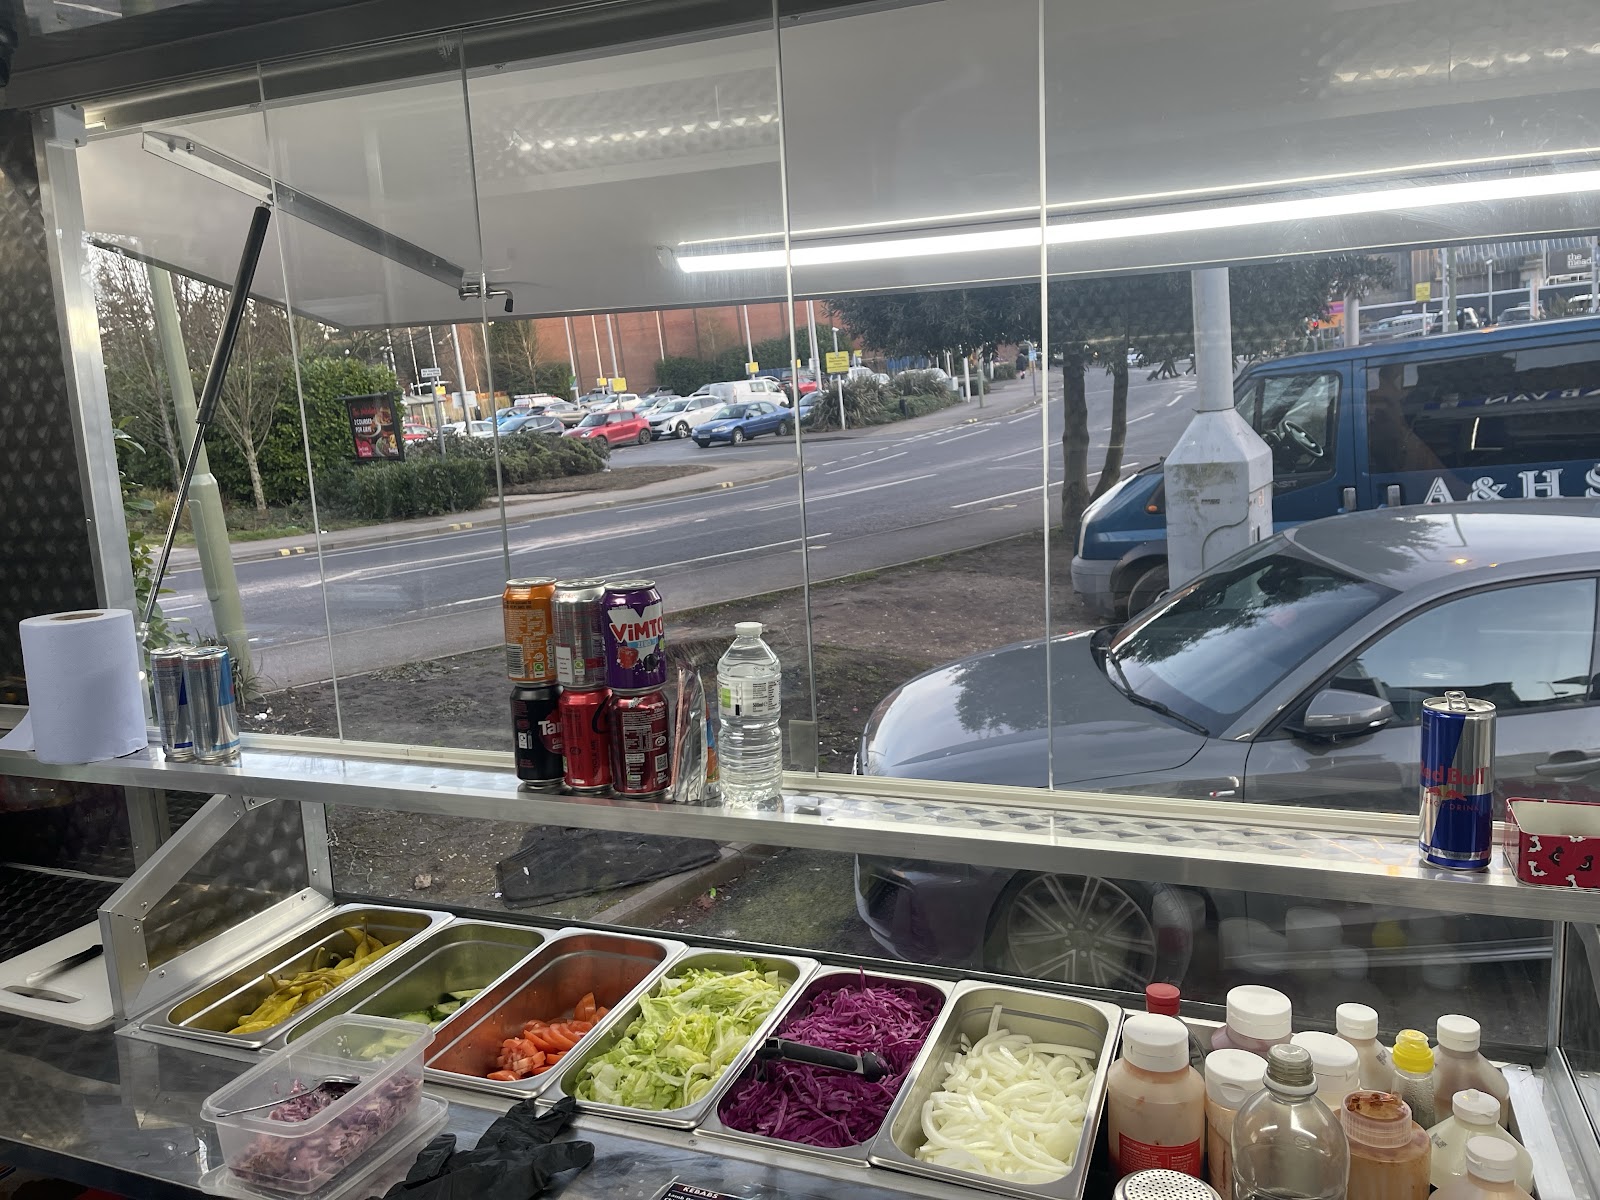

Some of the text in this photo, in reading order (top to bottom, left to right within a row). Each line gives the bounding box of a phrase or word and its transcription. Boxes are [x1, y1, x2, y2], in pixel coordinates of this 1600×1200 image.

[1567, 252, 1582, 260] the
[1567, 256, 1592, 266] mead
[1424, 476, 1454, 505] A
[1467, 476, 1507, 501] &
[1517, 468, 1564, 499] H
[1447, 767, 1485, 786] Bull
[1449, 803, 1480, 811] DRINK
[682, 1186, 719, 1199] KEBABS
